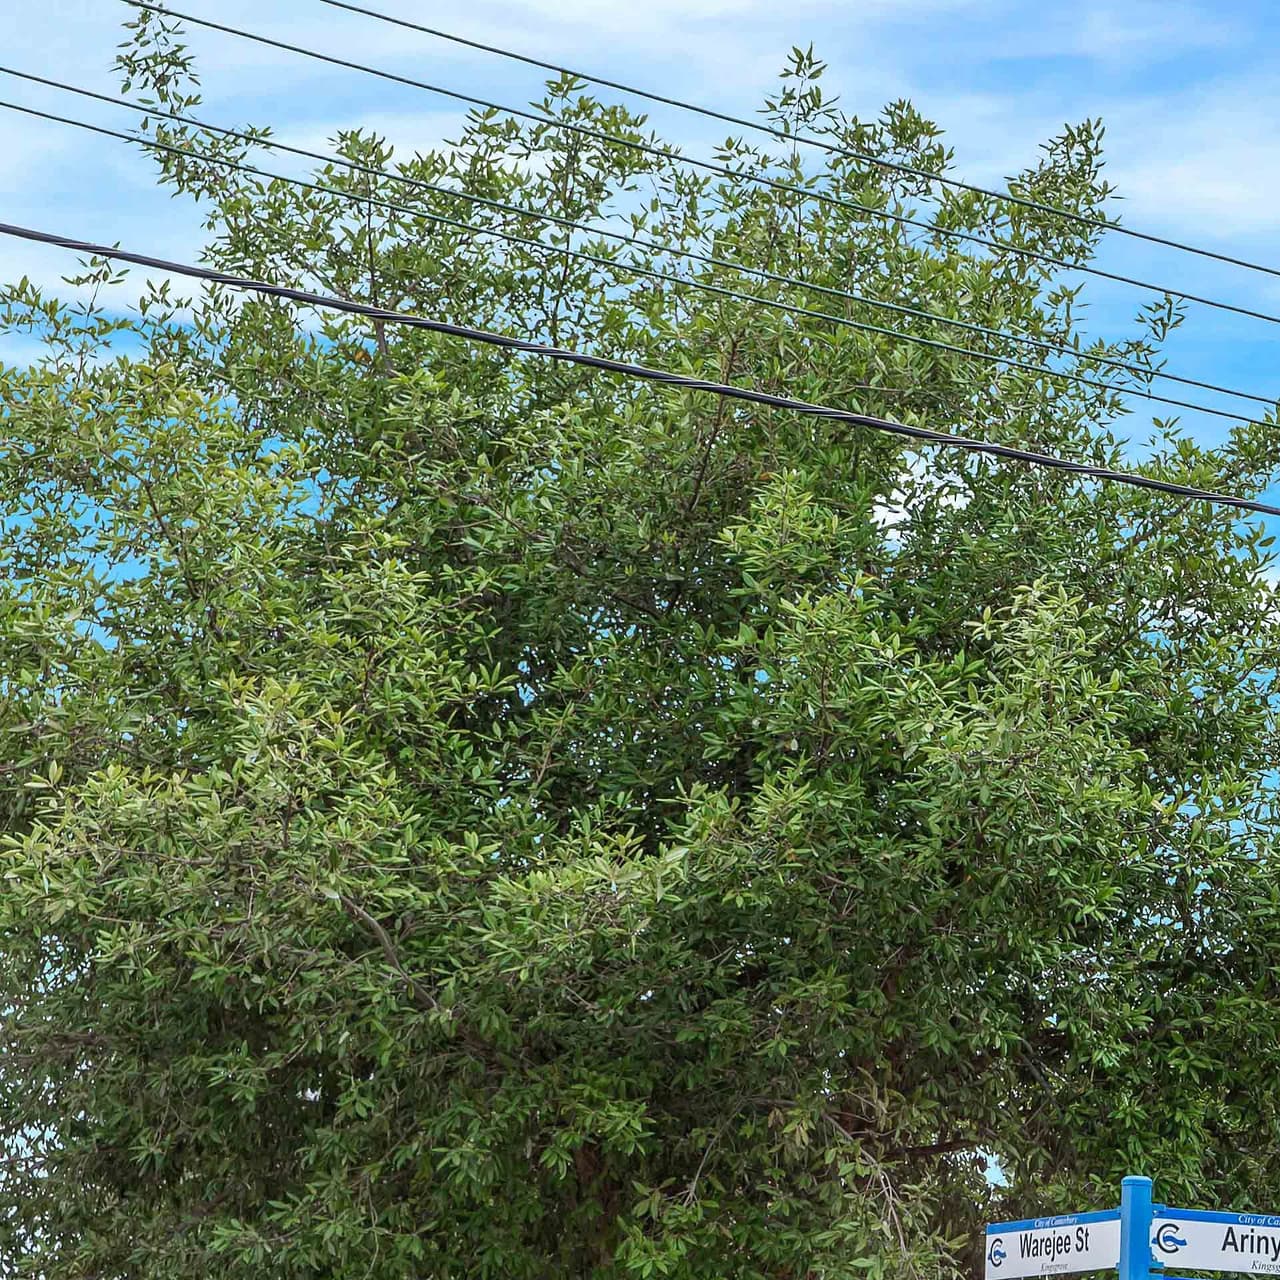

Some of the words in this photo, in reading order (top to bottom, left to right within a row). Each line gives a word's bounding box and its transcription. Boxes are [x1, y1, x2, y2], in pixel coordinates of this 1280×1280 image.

[1239, 1214, 1256, 1227] City
[1257, 1216, 1266, 1226] of
[1019, 1229, 1071, 1262] Warejee
[1075, 1226, 1090, 1253] St
